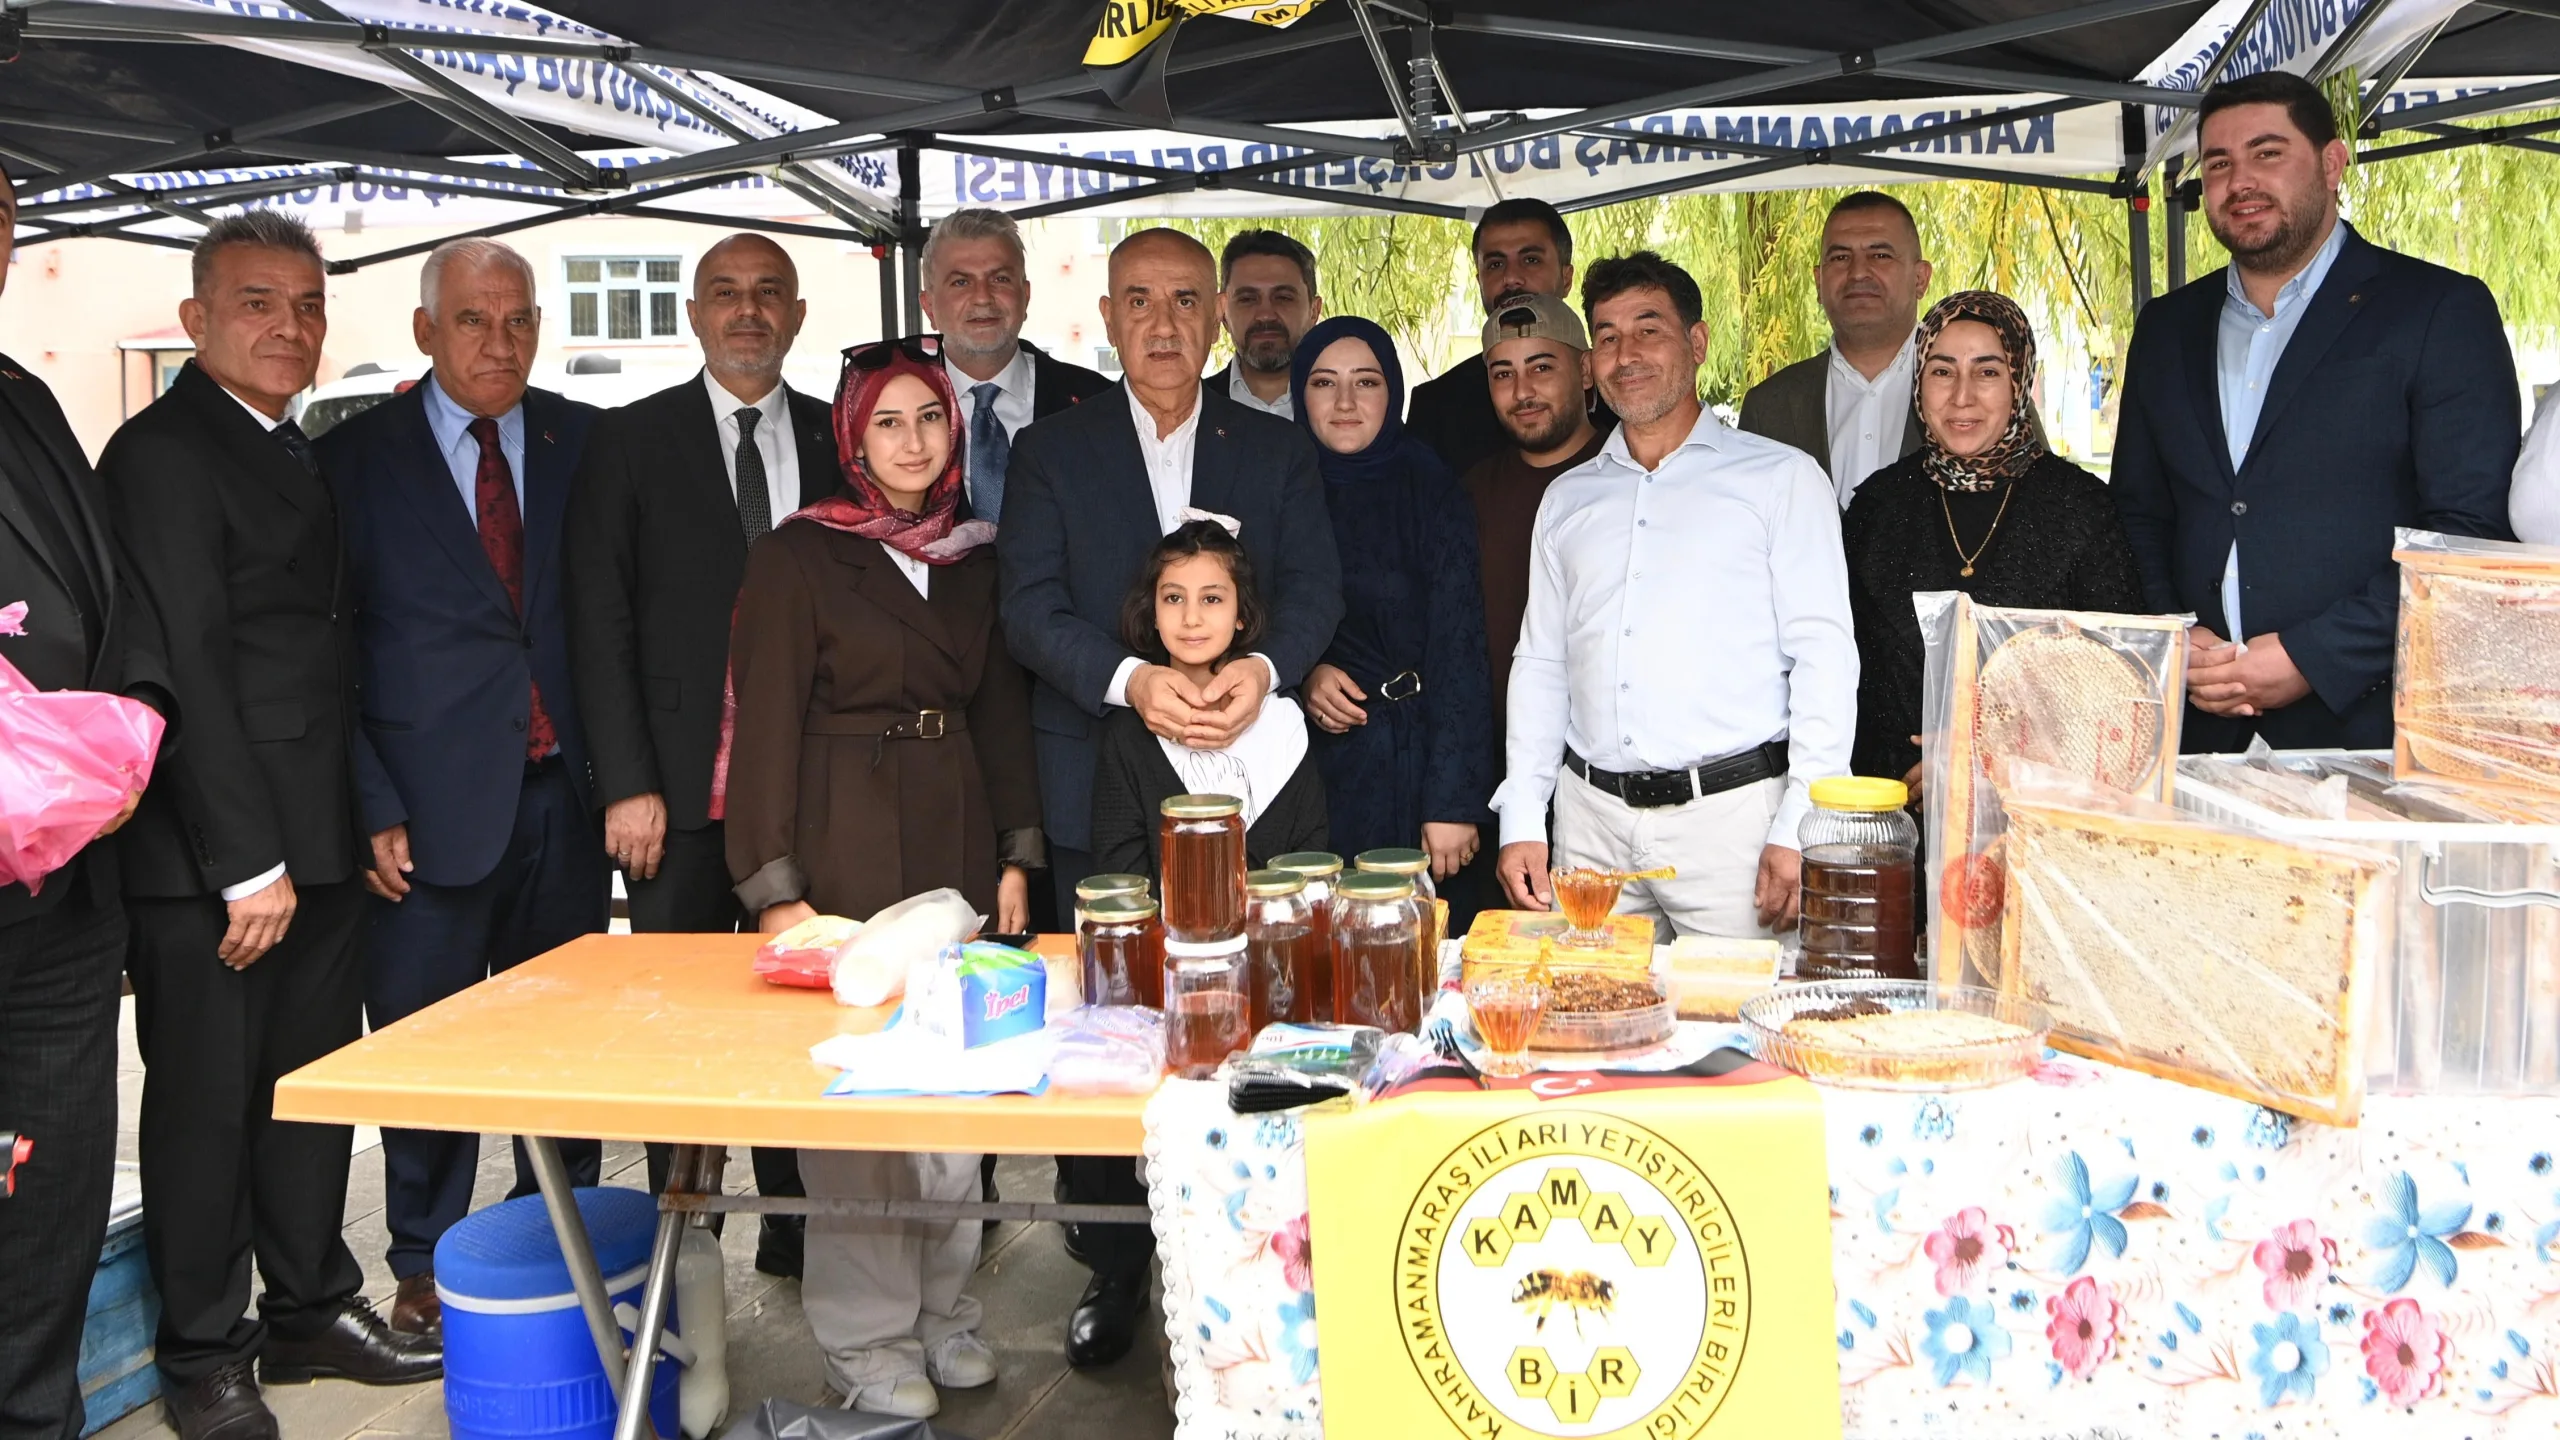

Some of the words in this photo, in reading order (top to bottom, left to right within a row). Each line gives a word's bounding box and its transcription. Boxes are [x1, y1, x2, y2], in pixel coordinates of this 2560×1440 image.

[1406, 1164, 1503, 1440] KAHRAMANMARAŞ
[1467, 1136, 1509, 1170] İLİ
[1517, 1122, 1567, 1151] ARI
[1580, 1122, 1737, 1331] YETİŞTİRİCİLERİ
